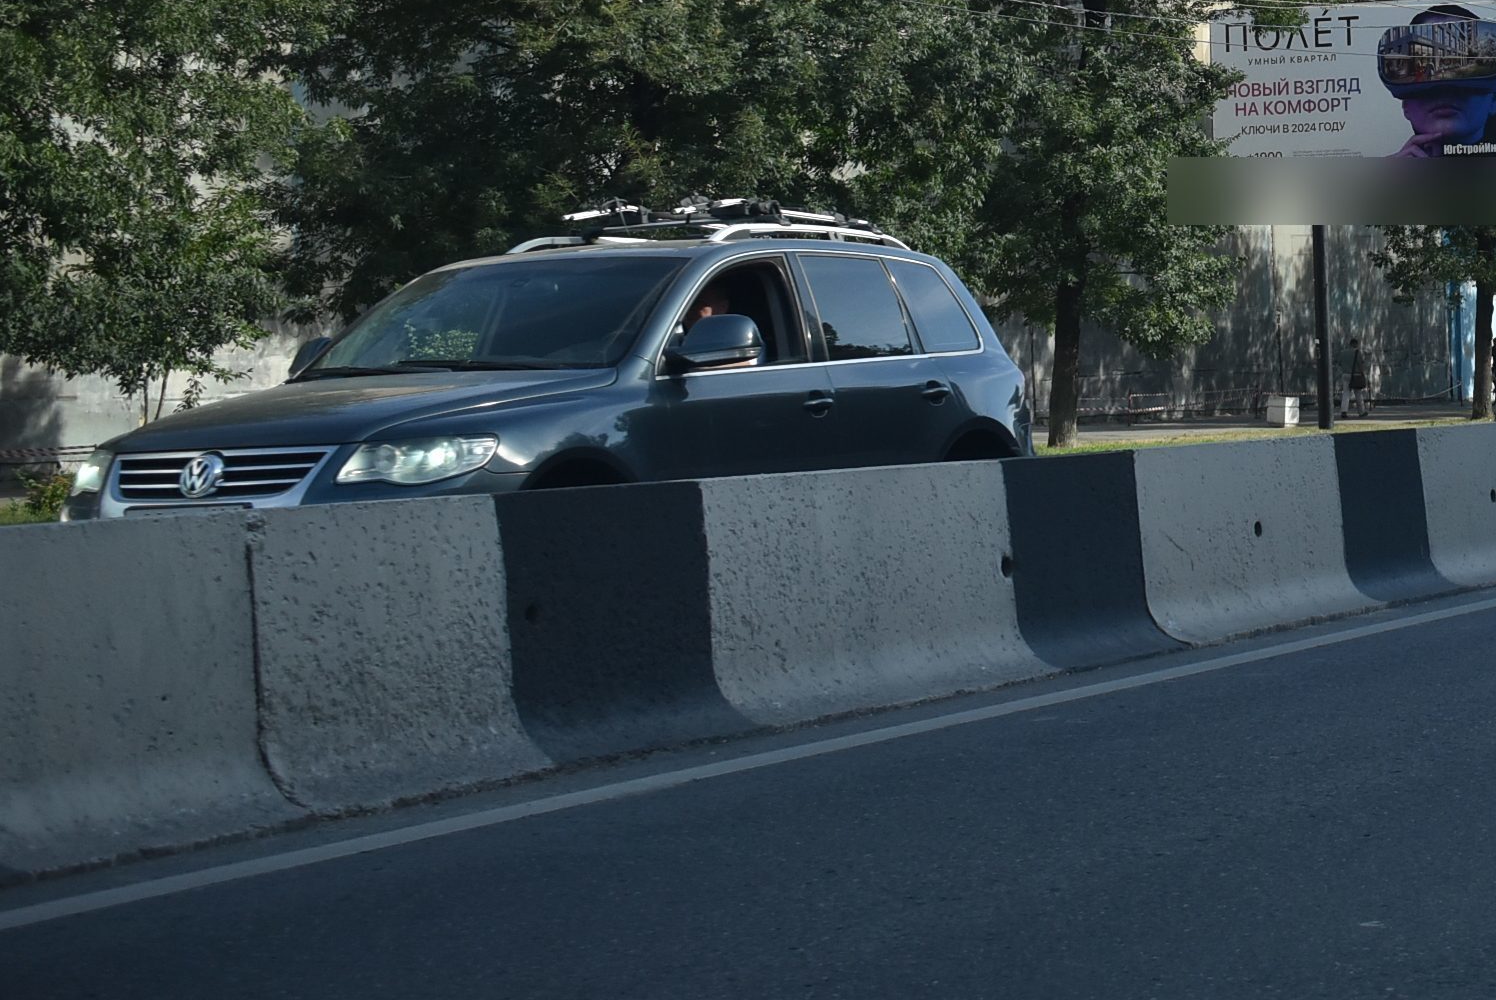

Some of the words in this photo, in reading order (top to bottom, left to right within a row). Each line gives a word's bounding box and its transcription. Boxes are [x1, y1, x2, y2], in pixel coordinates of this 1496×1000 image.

[1247, 55, 1286, 66] УМНЫЙ
[1289, 53, 1337, 64] КВАРТАЛ
[1294, 77, 1362, 95] ВЗГЛЯД
[1235, 102, 1259, 117] НА
[1263, 97, 1352, 116] КОМФОРТ
[1241, 125, 1281, 136] КЛЮЧИ
[1282, 124, 1290, 134] В
[1291, 122, 1317, 133] 2024
[1318, 121, 1346, 133] ГОДУ
